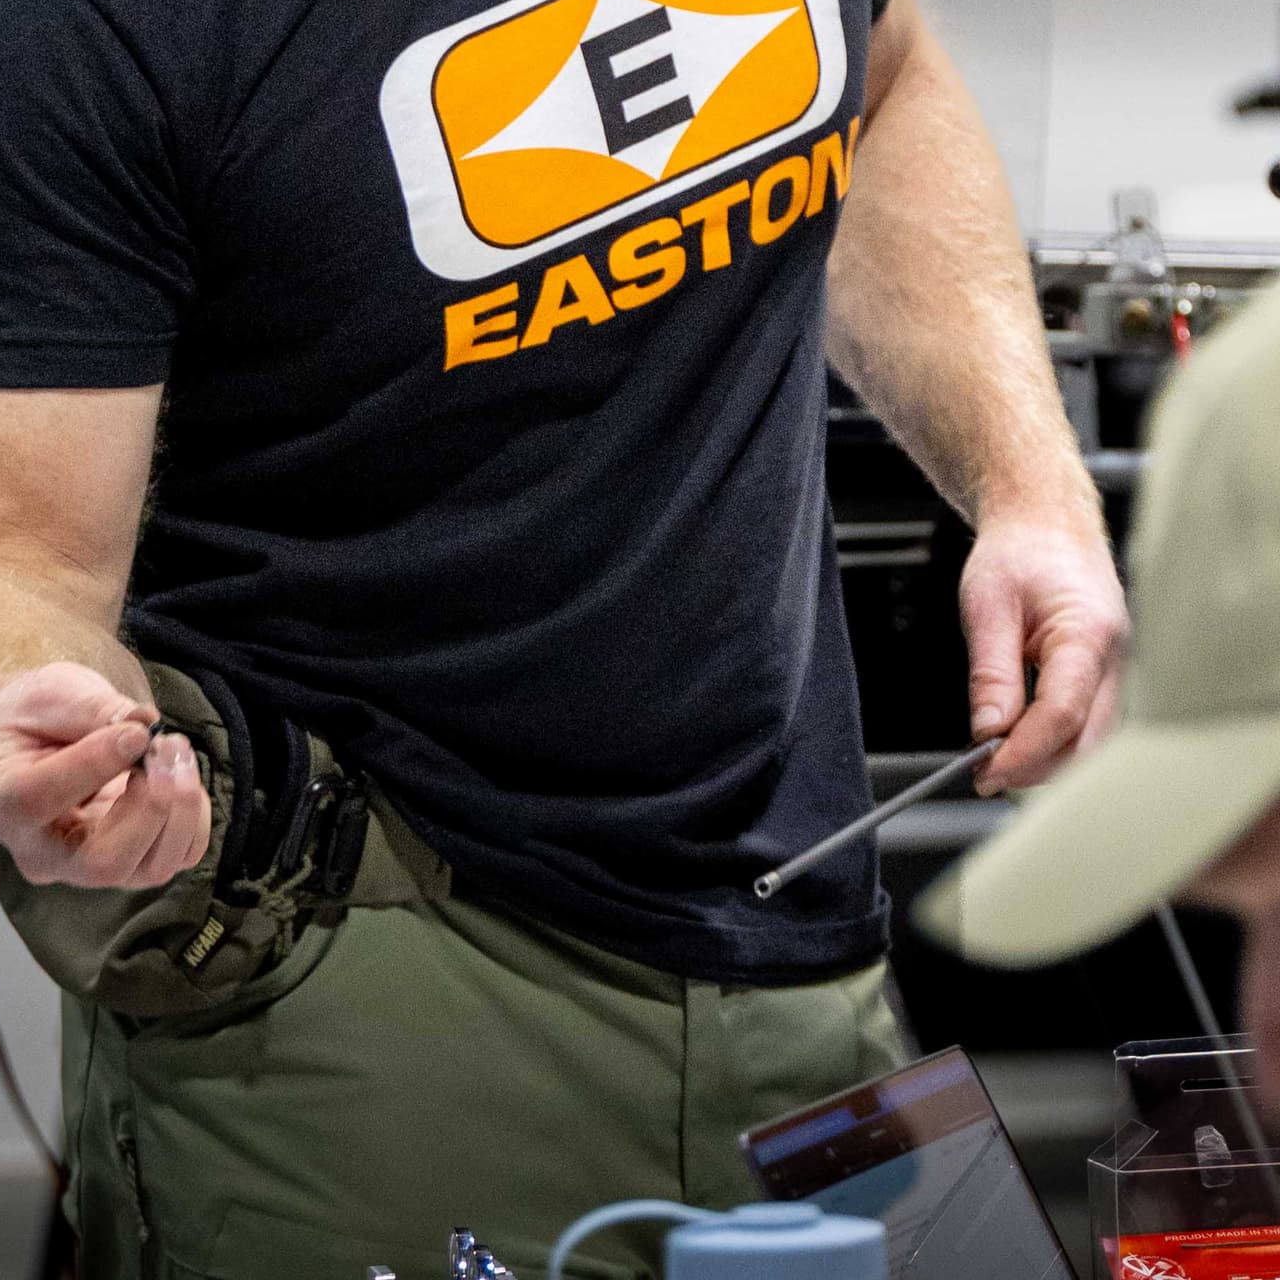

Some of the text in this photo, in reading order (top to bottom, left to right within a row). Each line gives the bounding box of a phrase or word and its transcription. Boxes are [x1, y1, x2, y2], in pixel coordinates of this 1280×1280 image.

[579, 5, 697, 157] E
[443, 116, 860, 372] EASTON
[183, 916, 224, 967] KIFARU
[1164, 1232, 1214, 1242] PROUDLY
[1216, 1229, 1247, 1238] MADE
